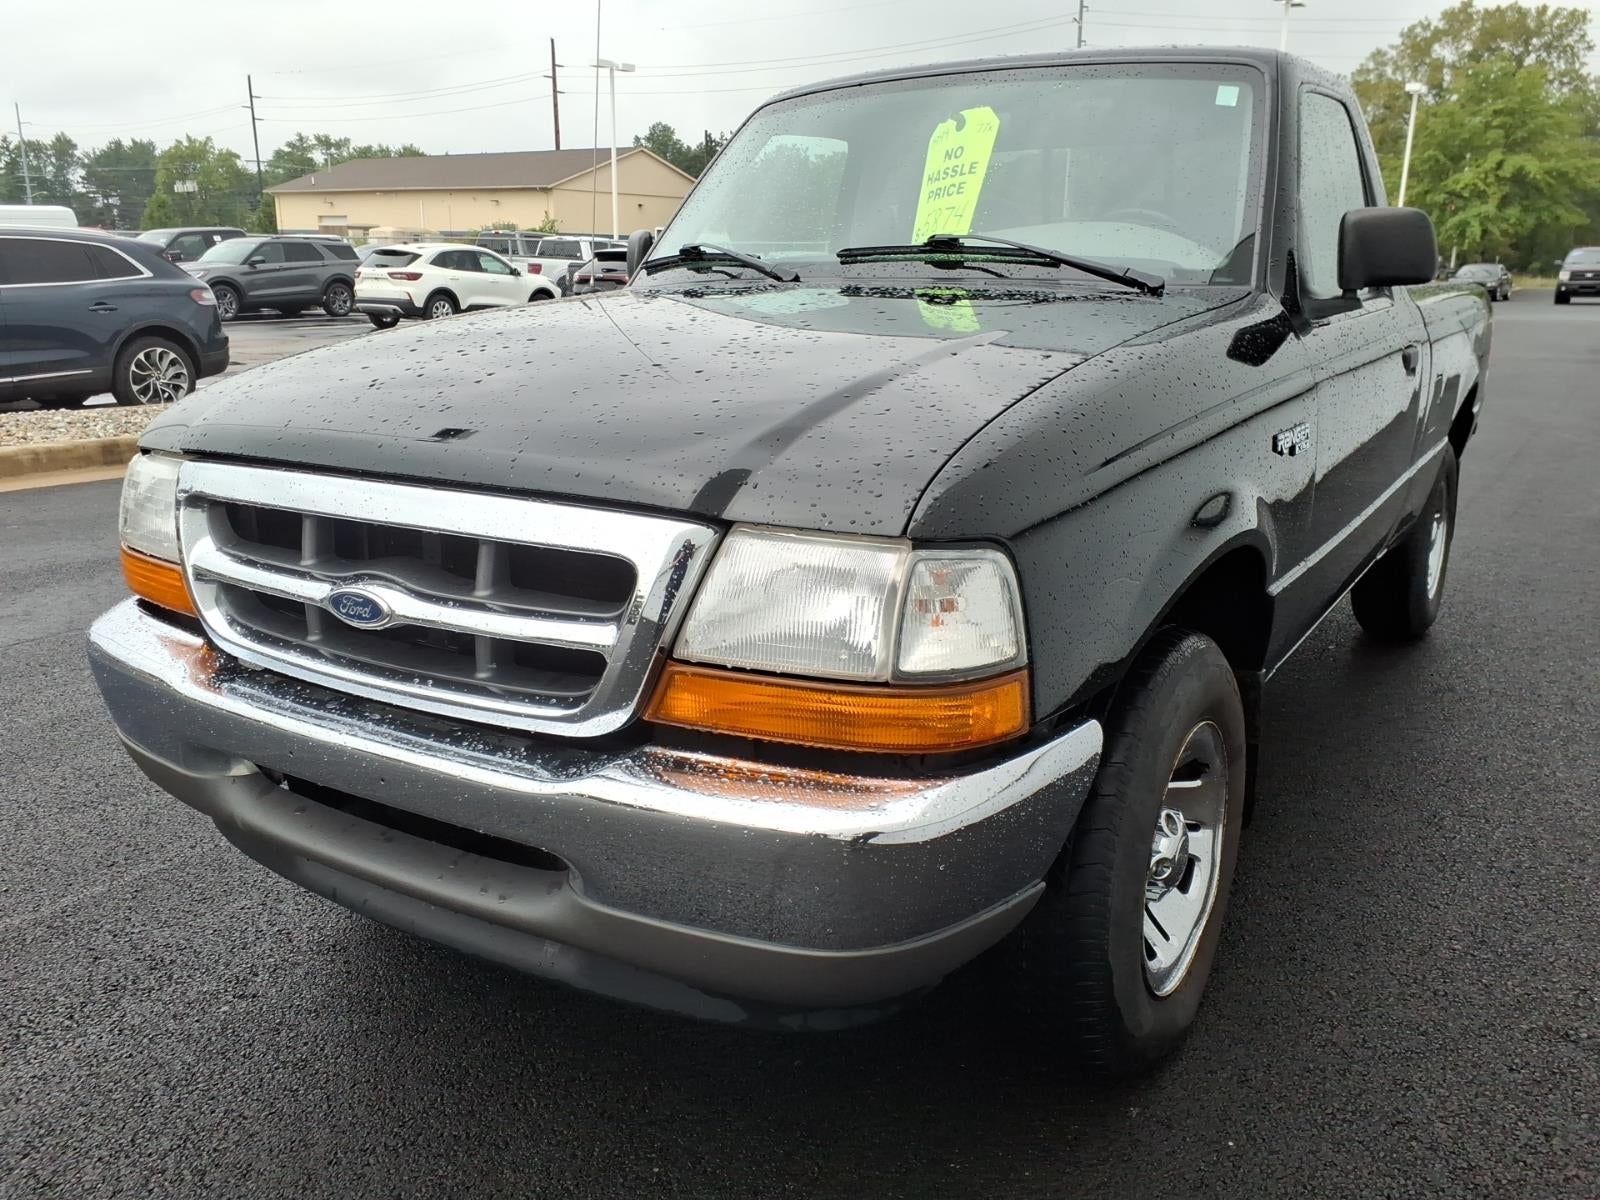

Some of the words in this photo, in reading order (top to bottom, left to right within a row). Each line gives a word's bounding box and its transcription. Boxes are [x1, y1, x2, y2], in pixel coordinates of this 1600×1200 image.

[943, 146, 964, 162] NO
[926, 161, 979, 186] HASSLE
[927, 181, 967, 203] PRICE
[340, 595, 372, 618] Ford
